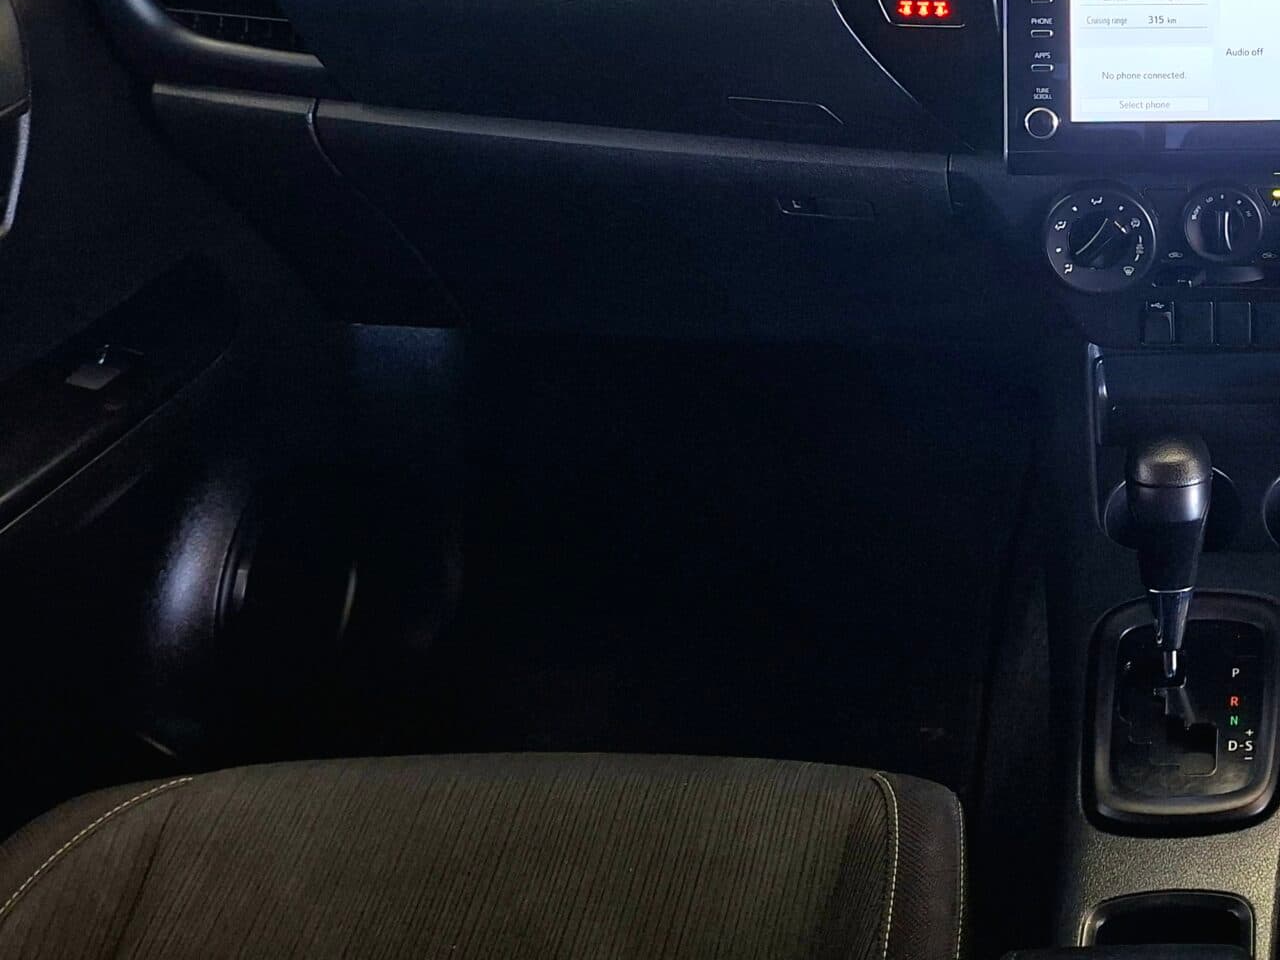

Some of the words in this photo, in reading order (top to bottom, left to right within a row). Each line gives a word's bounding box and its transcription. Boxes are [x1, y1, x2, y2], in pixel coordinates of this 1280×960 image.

[1031, 17, 1052, 25] PHONE
[1086, 16, 1110, 26] Cruising
[1111, 18, 1128, 27] range
[1147, 16, 1164, 25] 315
[1225, 48, 1250, 57] Audio
[1251, 47, 1264, 57] off
[1102, 72, 1115, 80] No
[1116, 72, 1142, 81] phone
[1143, 71, 1188, 80] connected.
[1119, 100, 1143, 109] Select
[1145, 100, 1171, 111] phone
[1231, 668, 1240, 678] P
[1230, 696, 1239, 707] R
[1230, 715, 1239, 726] N
